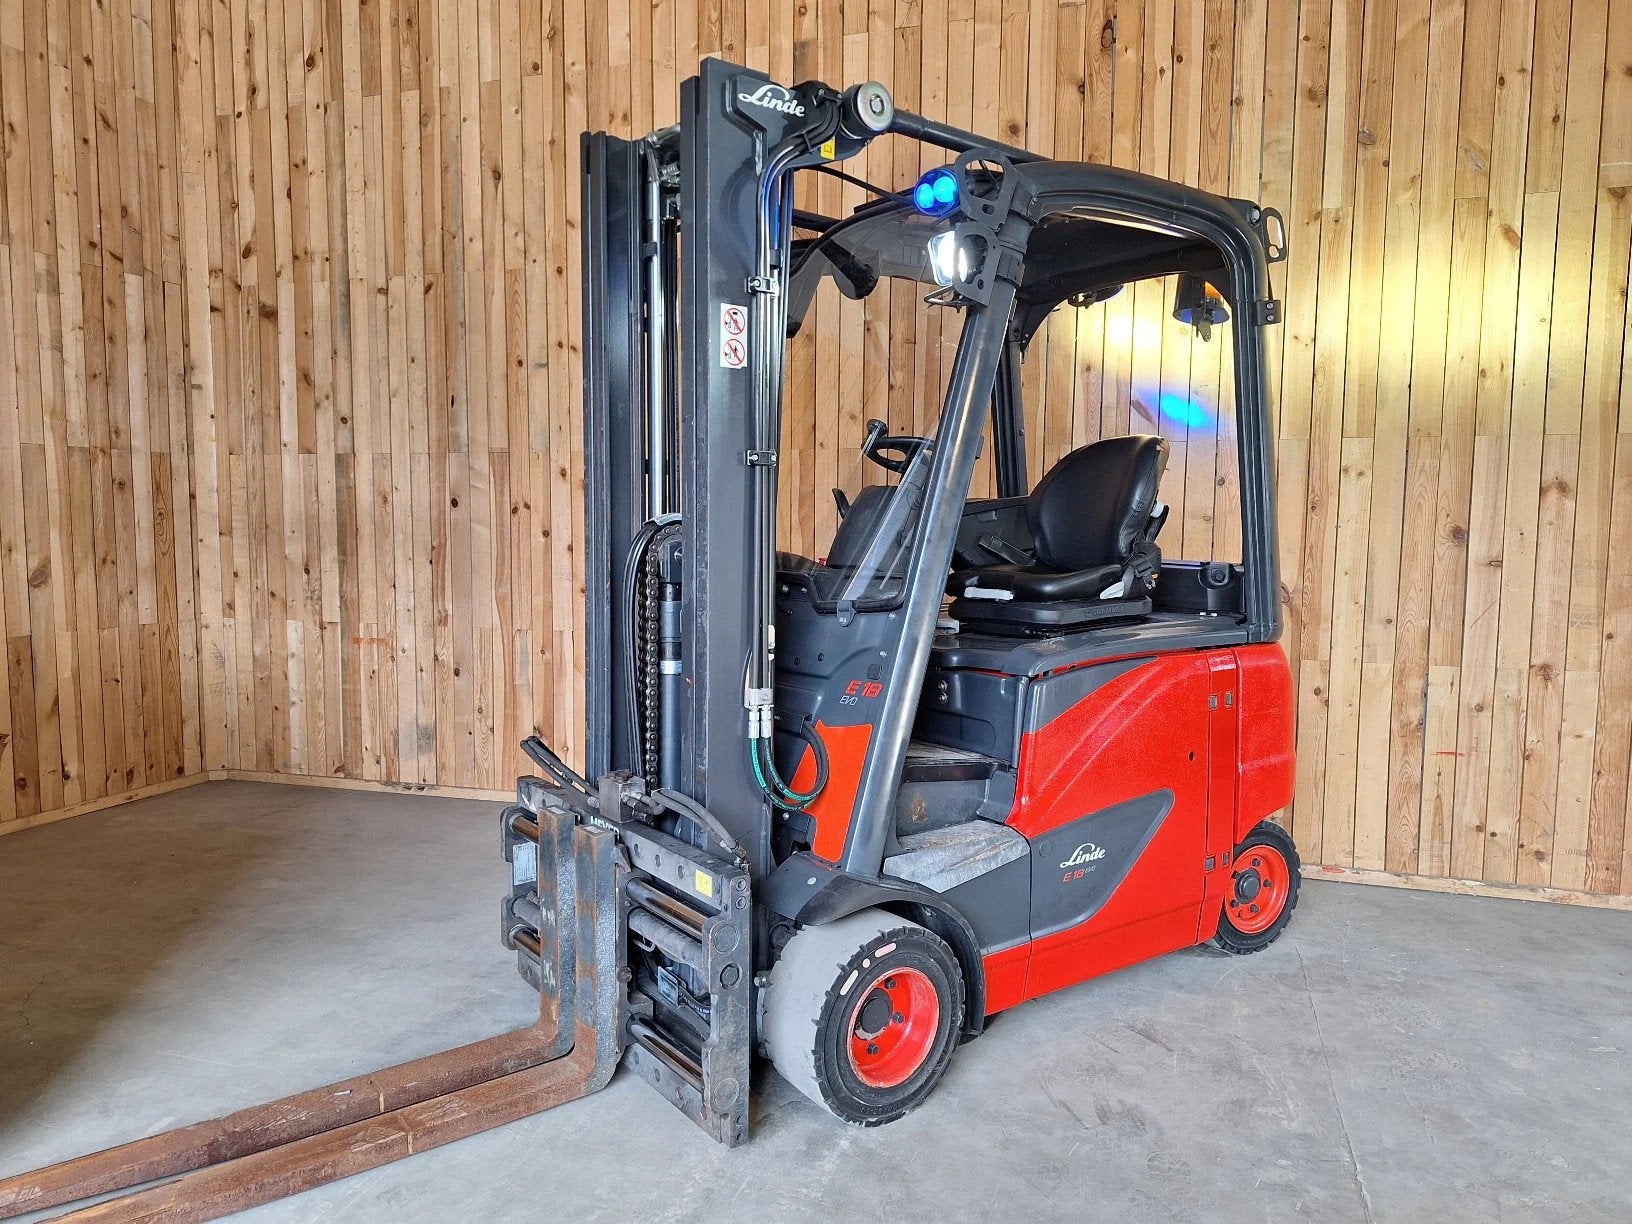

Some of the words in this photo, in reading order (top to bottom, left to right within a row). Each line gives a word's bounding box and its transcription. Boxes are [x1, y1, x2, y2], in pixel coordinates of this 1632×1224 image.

[737, 84, 805, 117] Linde
[838, 695, 859, 706] EVO
[1059, 842, 1106, 868] Linde
